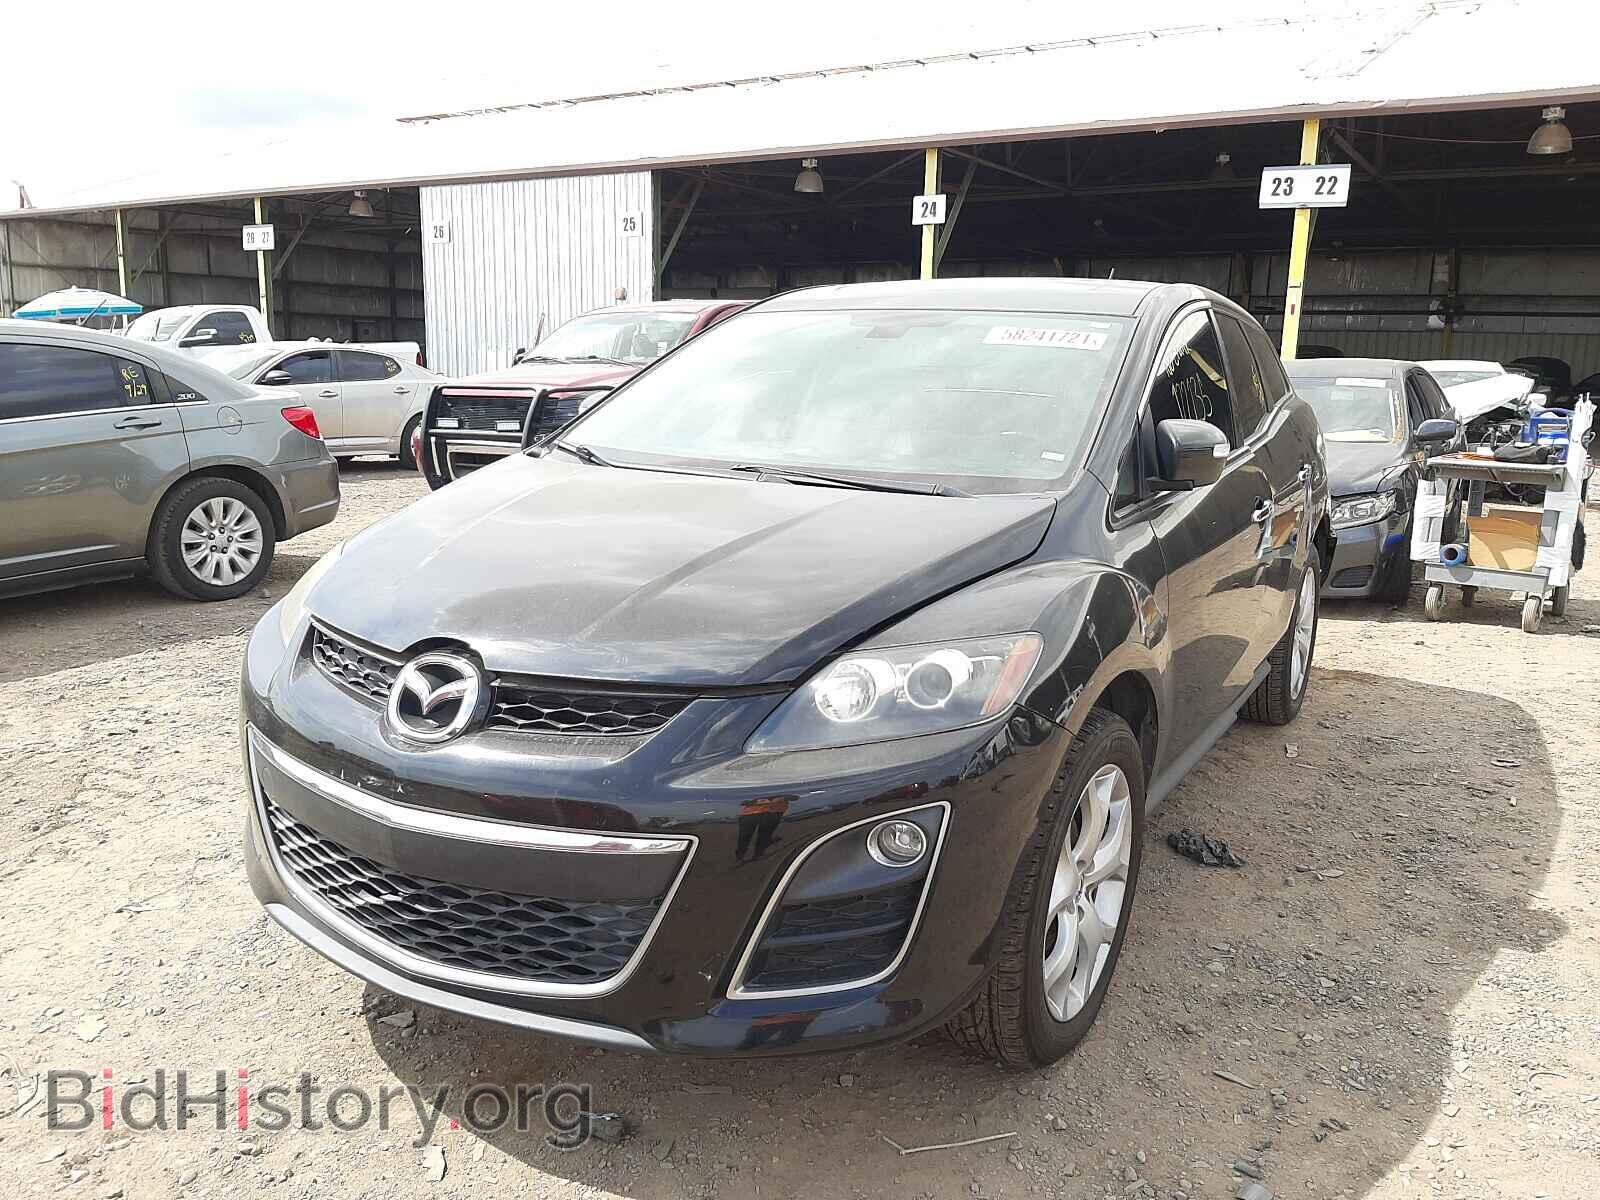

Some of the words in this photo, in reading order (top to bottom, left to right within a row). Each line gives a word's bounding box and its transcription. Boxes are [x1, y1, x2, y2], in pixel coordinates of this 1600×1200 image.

[1271, 177, 1294, 196] 23
[1315, 176, 1338, 195] 22
[921, 201, 937, 218] 24
[623, 217, 636, 231] 25
[262, 232, 270, 244] 27
[433, 226, 444, 238] 26
[122, 366, 139, 382] RE
[177, 393, 195, 401] 200
